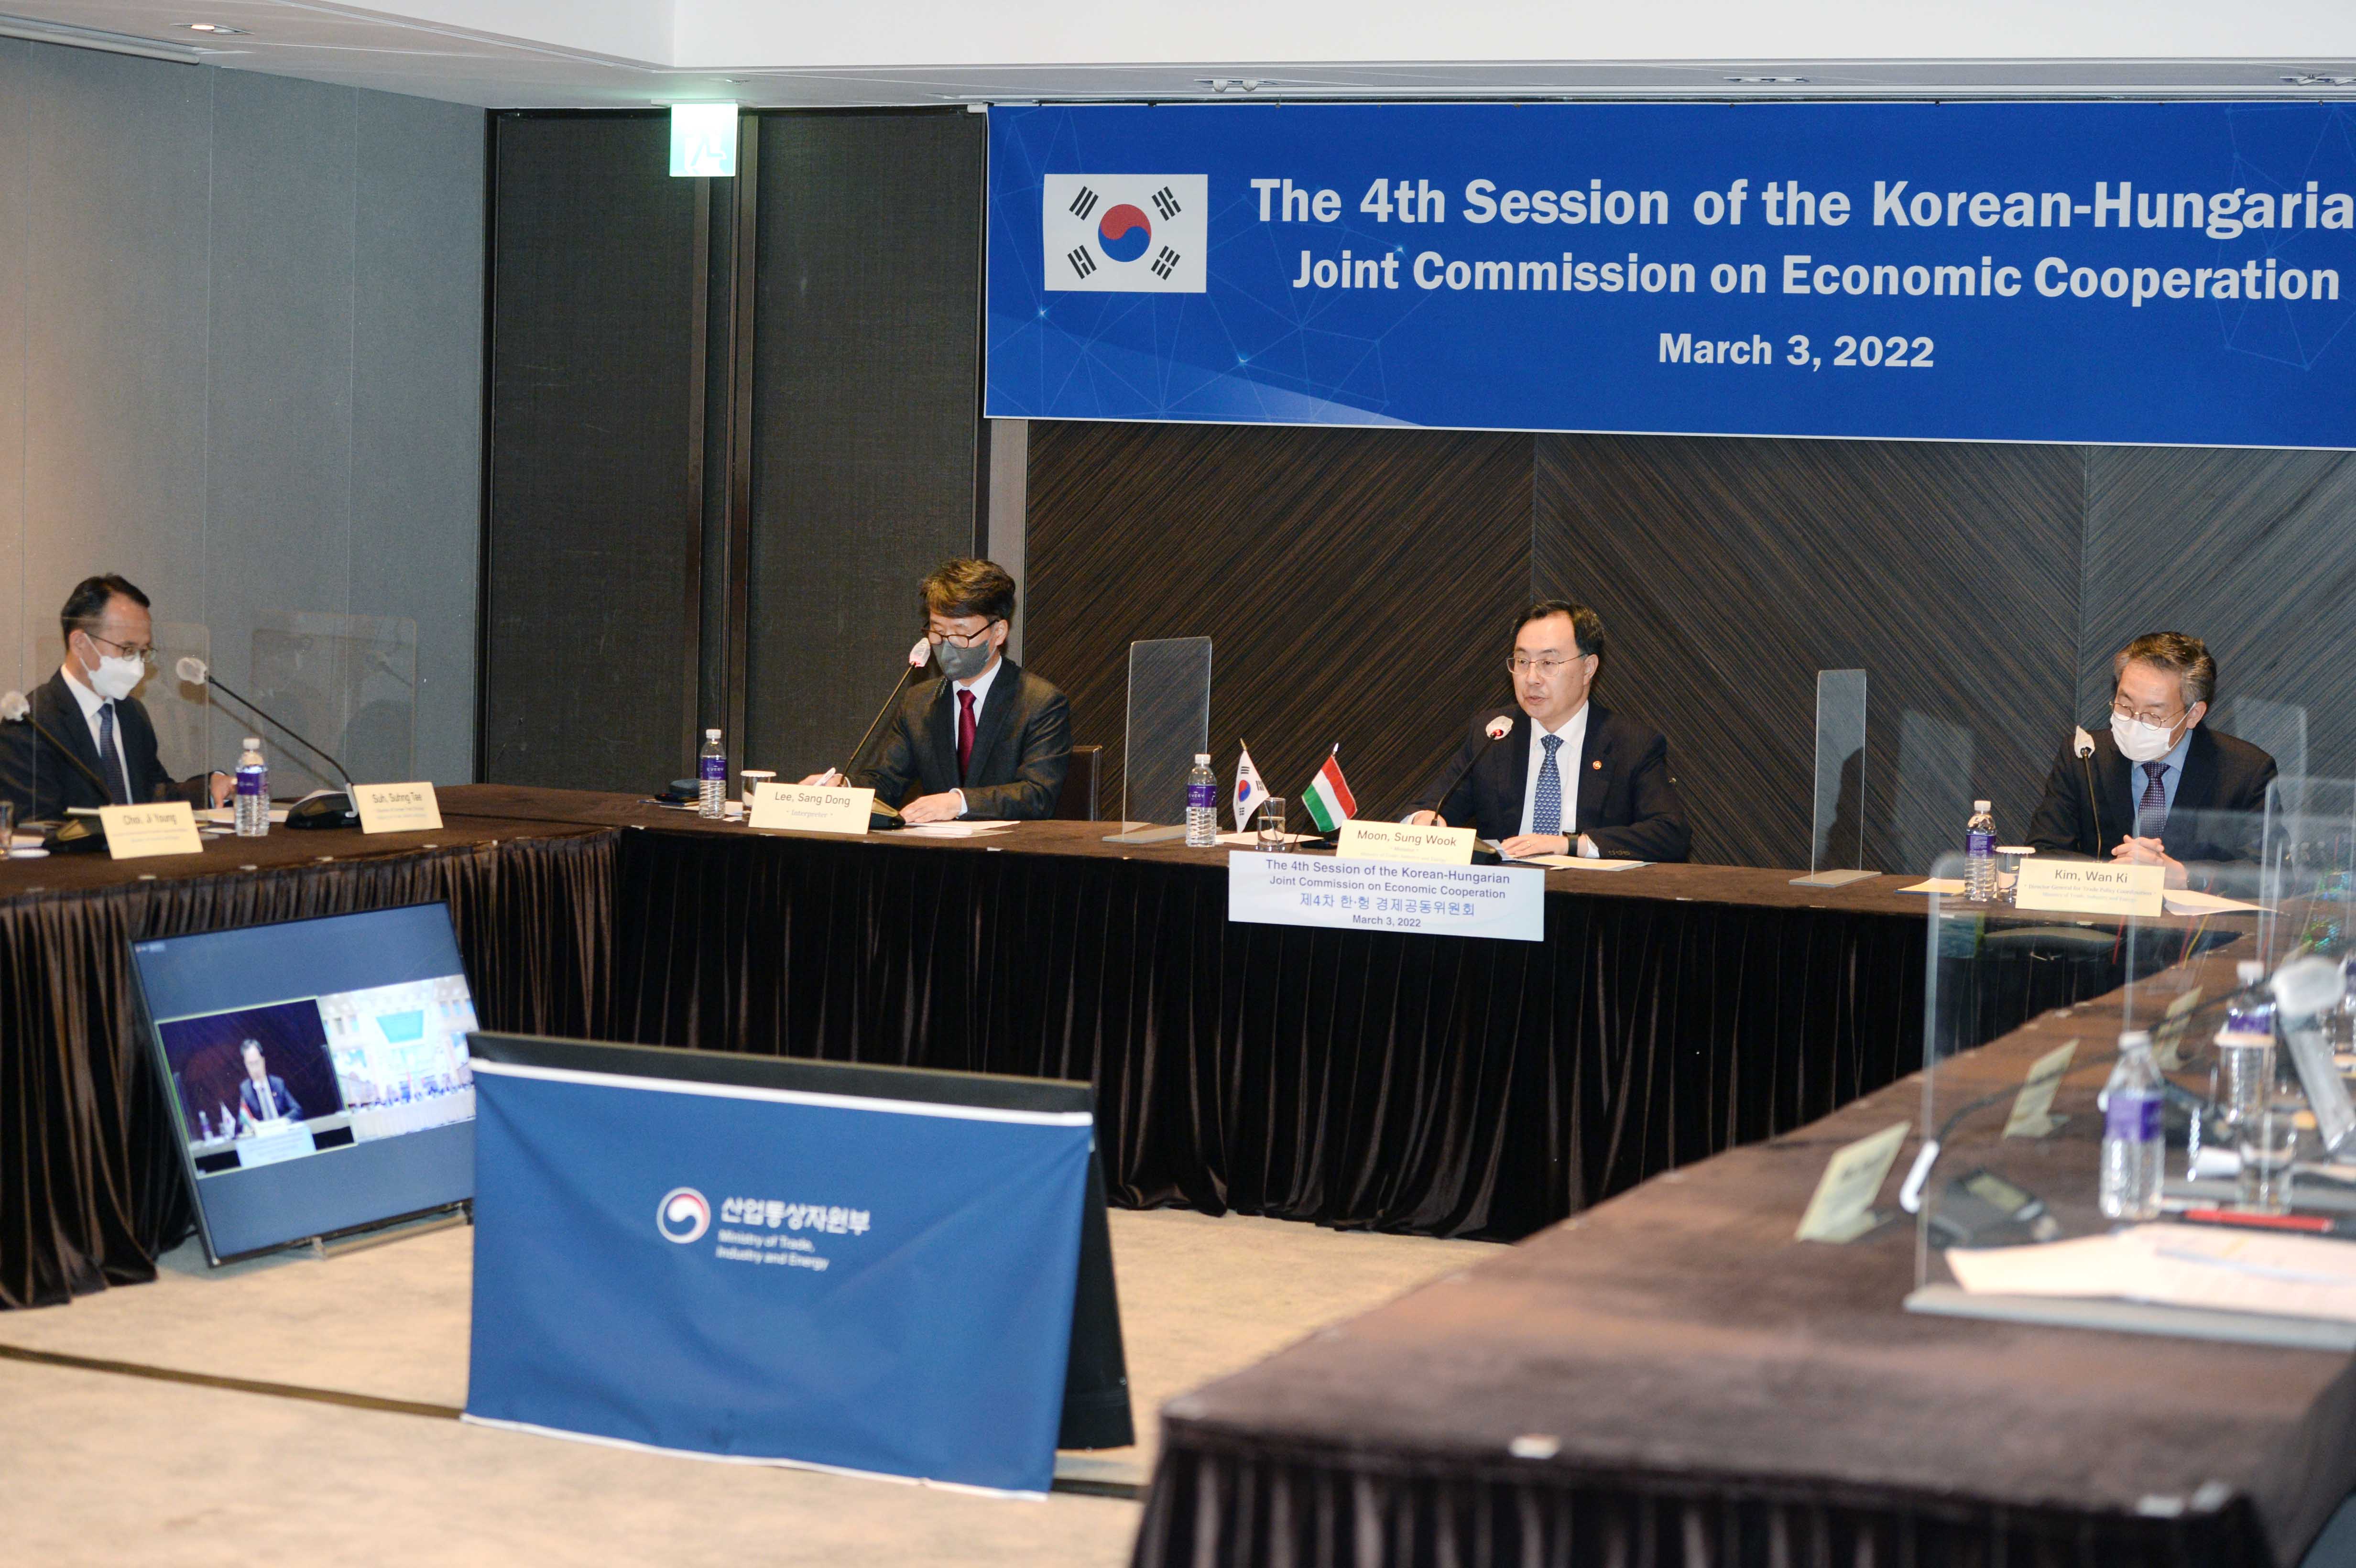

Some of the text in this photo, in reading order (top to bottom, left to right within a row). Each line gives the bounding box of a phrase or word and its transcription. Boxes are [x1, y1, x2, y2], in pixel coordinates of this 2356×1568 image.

[1251, 178, 2354, 240] The 4th Session of the Korean-Hungaria
[1293, 250, 2339, 307] Joint Commission on Economic Cooperation
[1659, 333, 1934, 372] March 3, 2022
[775, 792, 851, 807] Lee, Sang Dong
[154, 814, 177, 826] Young
[1357, 830, 1457, 847] Moon, Sung Wook
[1266, 860, 1510, 884] The 4th Session of the Korean-Hungarian
[2055, 869, 2128, 883] Kim, Wan Ki
[1270, 876, 1505, 899] Joint Commission on Economic Cooperation
[1300, 893, 1335, 907] 제4차
[1377, 897, 1474, 916] 경제공동위원회
[1353, 915, 1421, 927] March 3, 2022
[720, 1197, 871, 1236] 산업통상자원부
